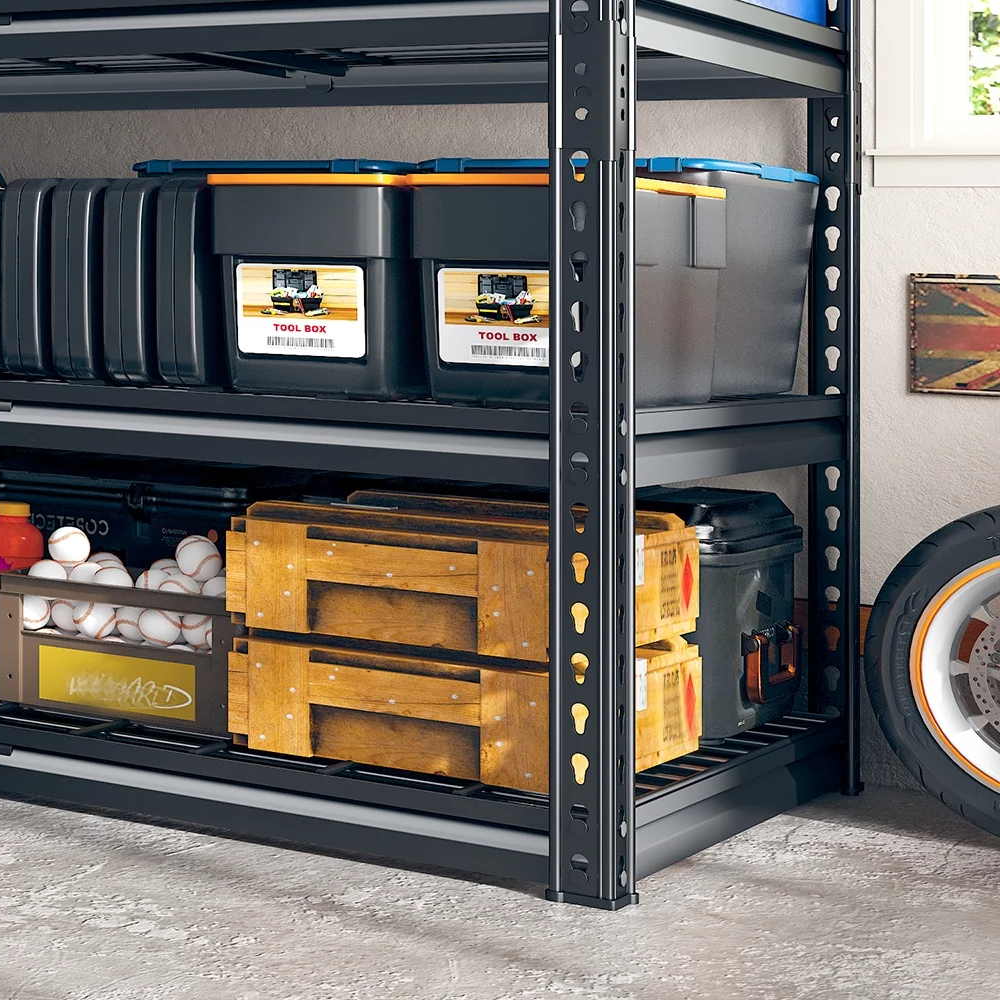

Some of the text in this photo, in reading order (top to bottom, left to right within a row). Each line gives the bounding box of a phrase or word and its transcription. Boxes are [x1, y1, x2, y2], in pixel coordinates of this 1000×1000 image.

[273, 324, 327, 333] TOOL BOX
[479, 332, 537, 341] TOOL BOX
